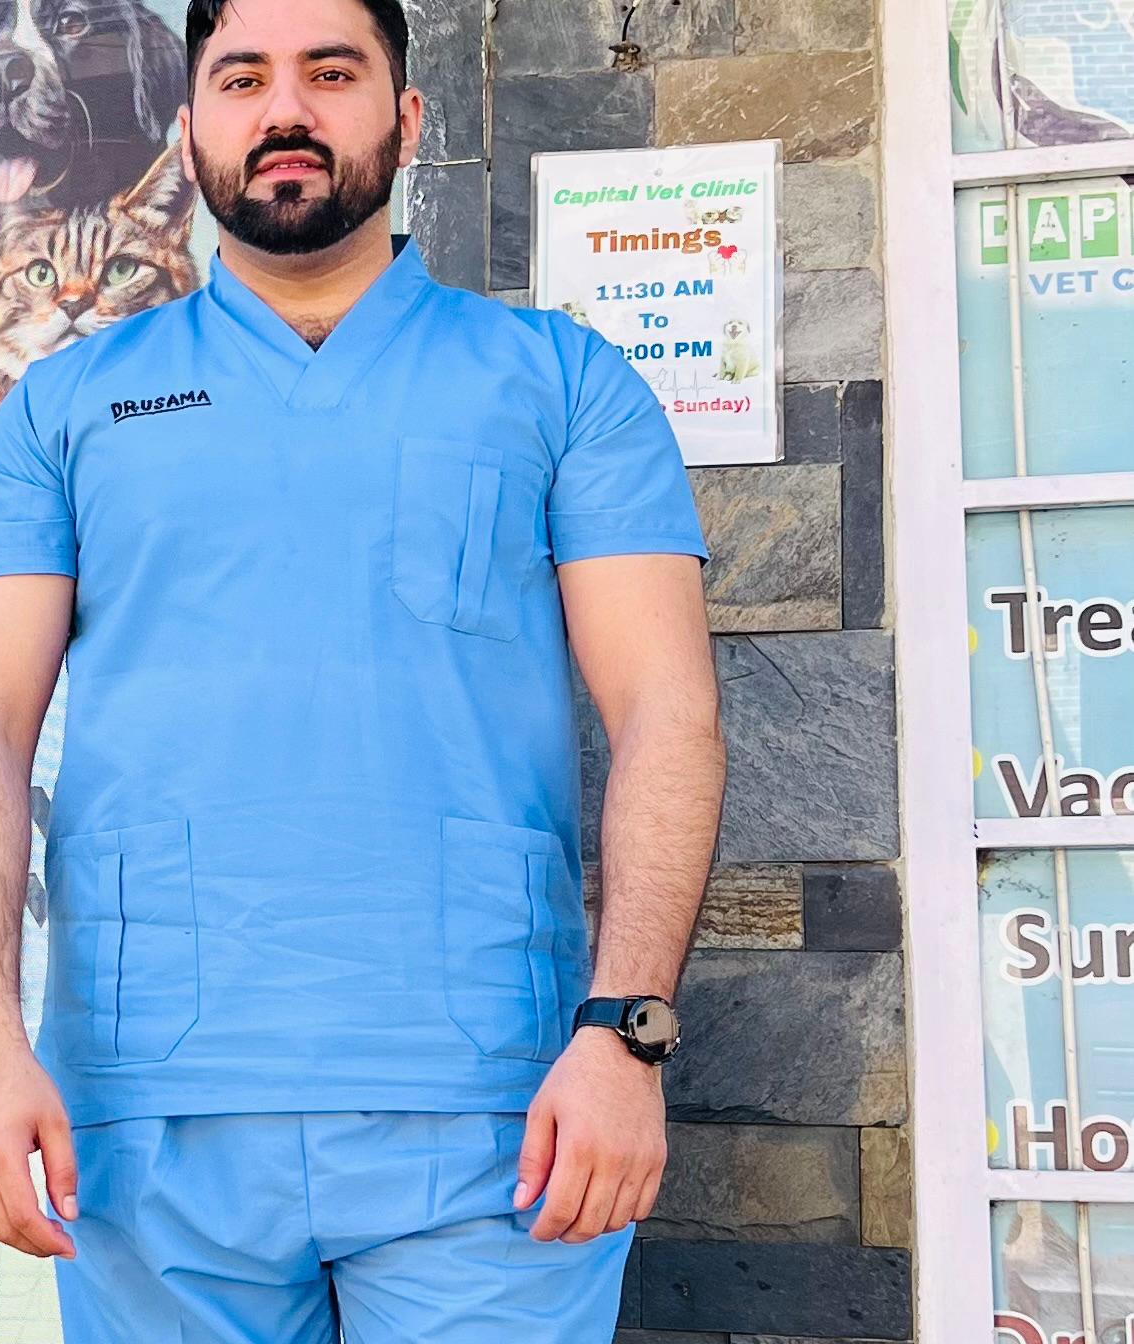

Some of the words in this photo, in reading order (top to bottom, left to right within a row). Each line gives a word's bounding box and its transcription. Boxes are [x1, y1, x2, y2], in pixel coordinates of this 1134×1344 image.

[553, 185, 639, 207] Capital
[645, 184, 684, 202] Vet
[690, 178, 758, 198] Clinic
[586, 227, 723, 255] Timings
[596, 281, 665, 301] 11:30
[673, 279, 714, 297] AM
[1028, 269, 1099, 296] VET
[638, 312, 669, 329] To
[674, 340, 713, 359] PM
[673, 396, 751, 414] Sunday)
